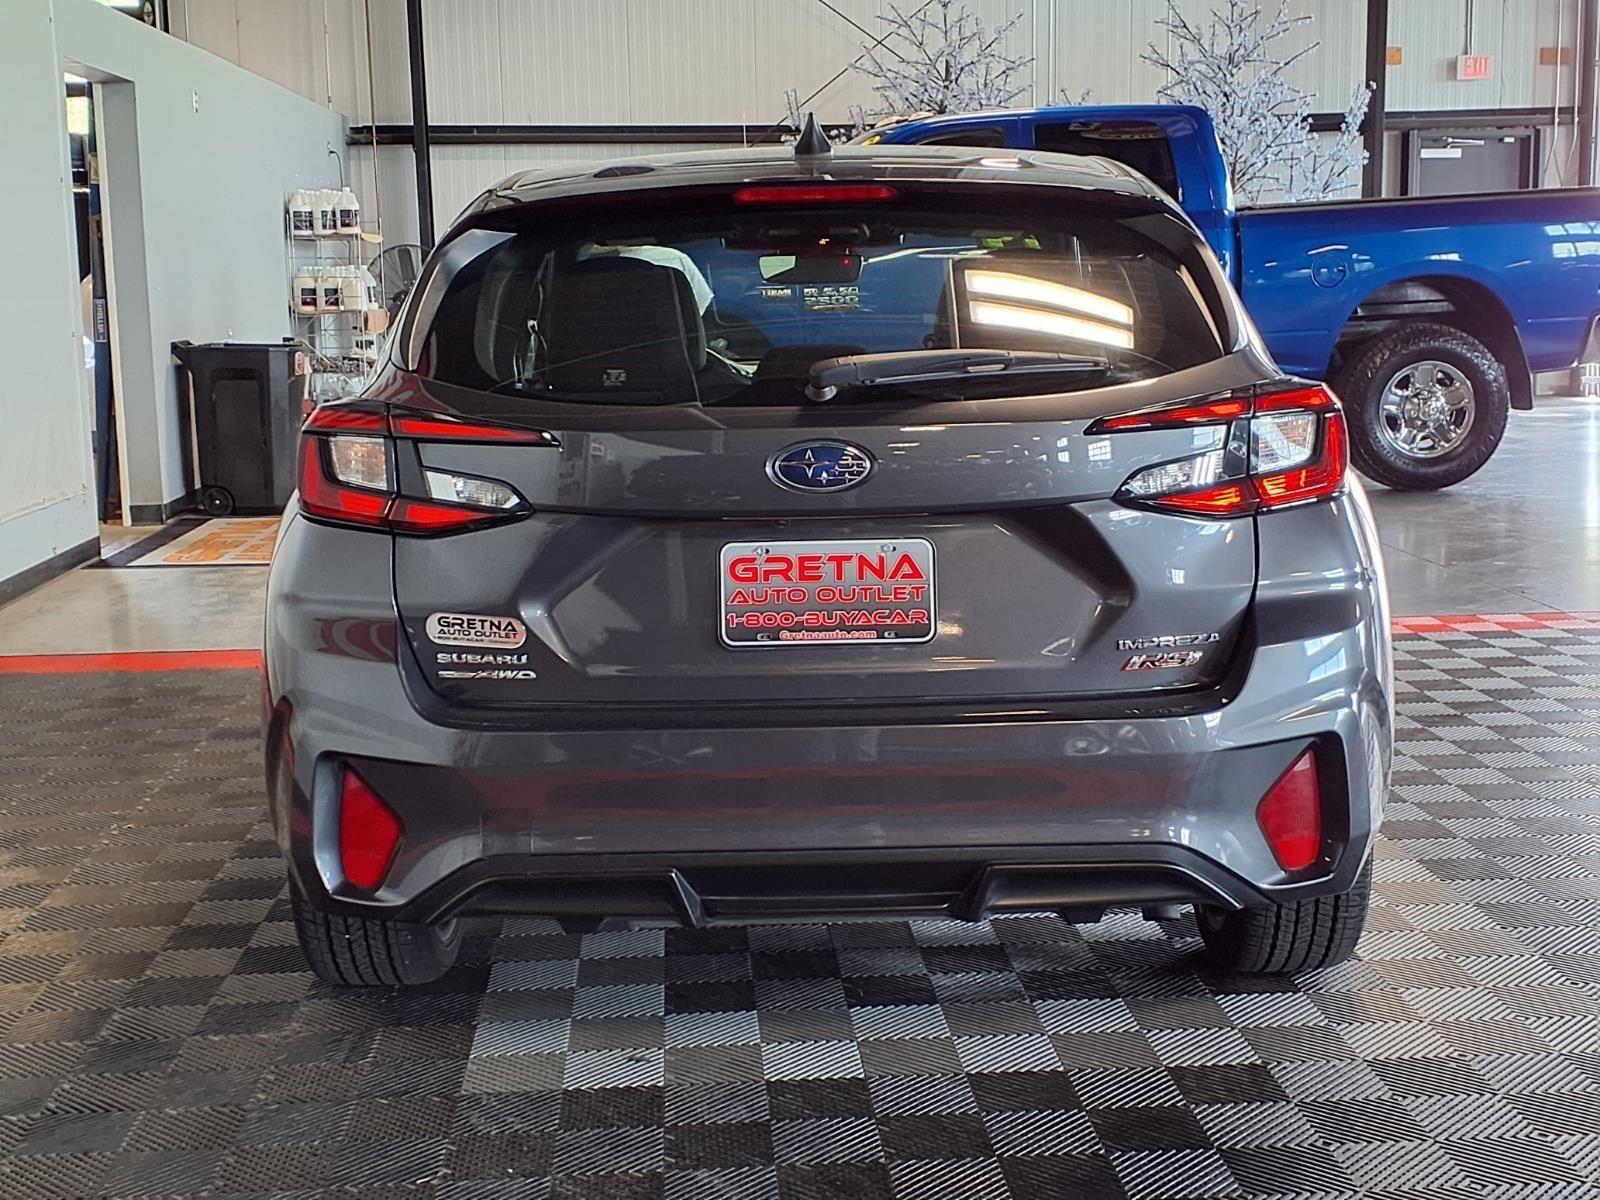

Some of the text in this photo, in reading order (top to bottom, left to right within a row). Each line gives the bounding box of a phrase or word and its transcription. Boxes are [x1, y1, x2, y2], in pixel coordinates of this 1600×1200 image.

[1464, 56, 1488, 76] EXIT
[804, 296, 859, 305] 2500
[727, 552, 927, 584] GRETNA
[727, 584, 928, 605] AUTO OUTLET
[437, 616, 518, 632] GRETNA
[727, 609, 929, 628] 1-800-BUYACAR
[438, 628, 519, 640] AUTO OUTLET
[779, 629, 877, 641] Gretnaauto.com
[1117, 633, 1220, 650] IMPREZA
[436, 652, 528, 665] SUBARU
